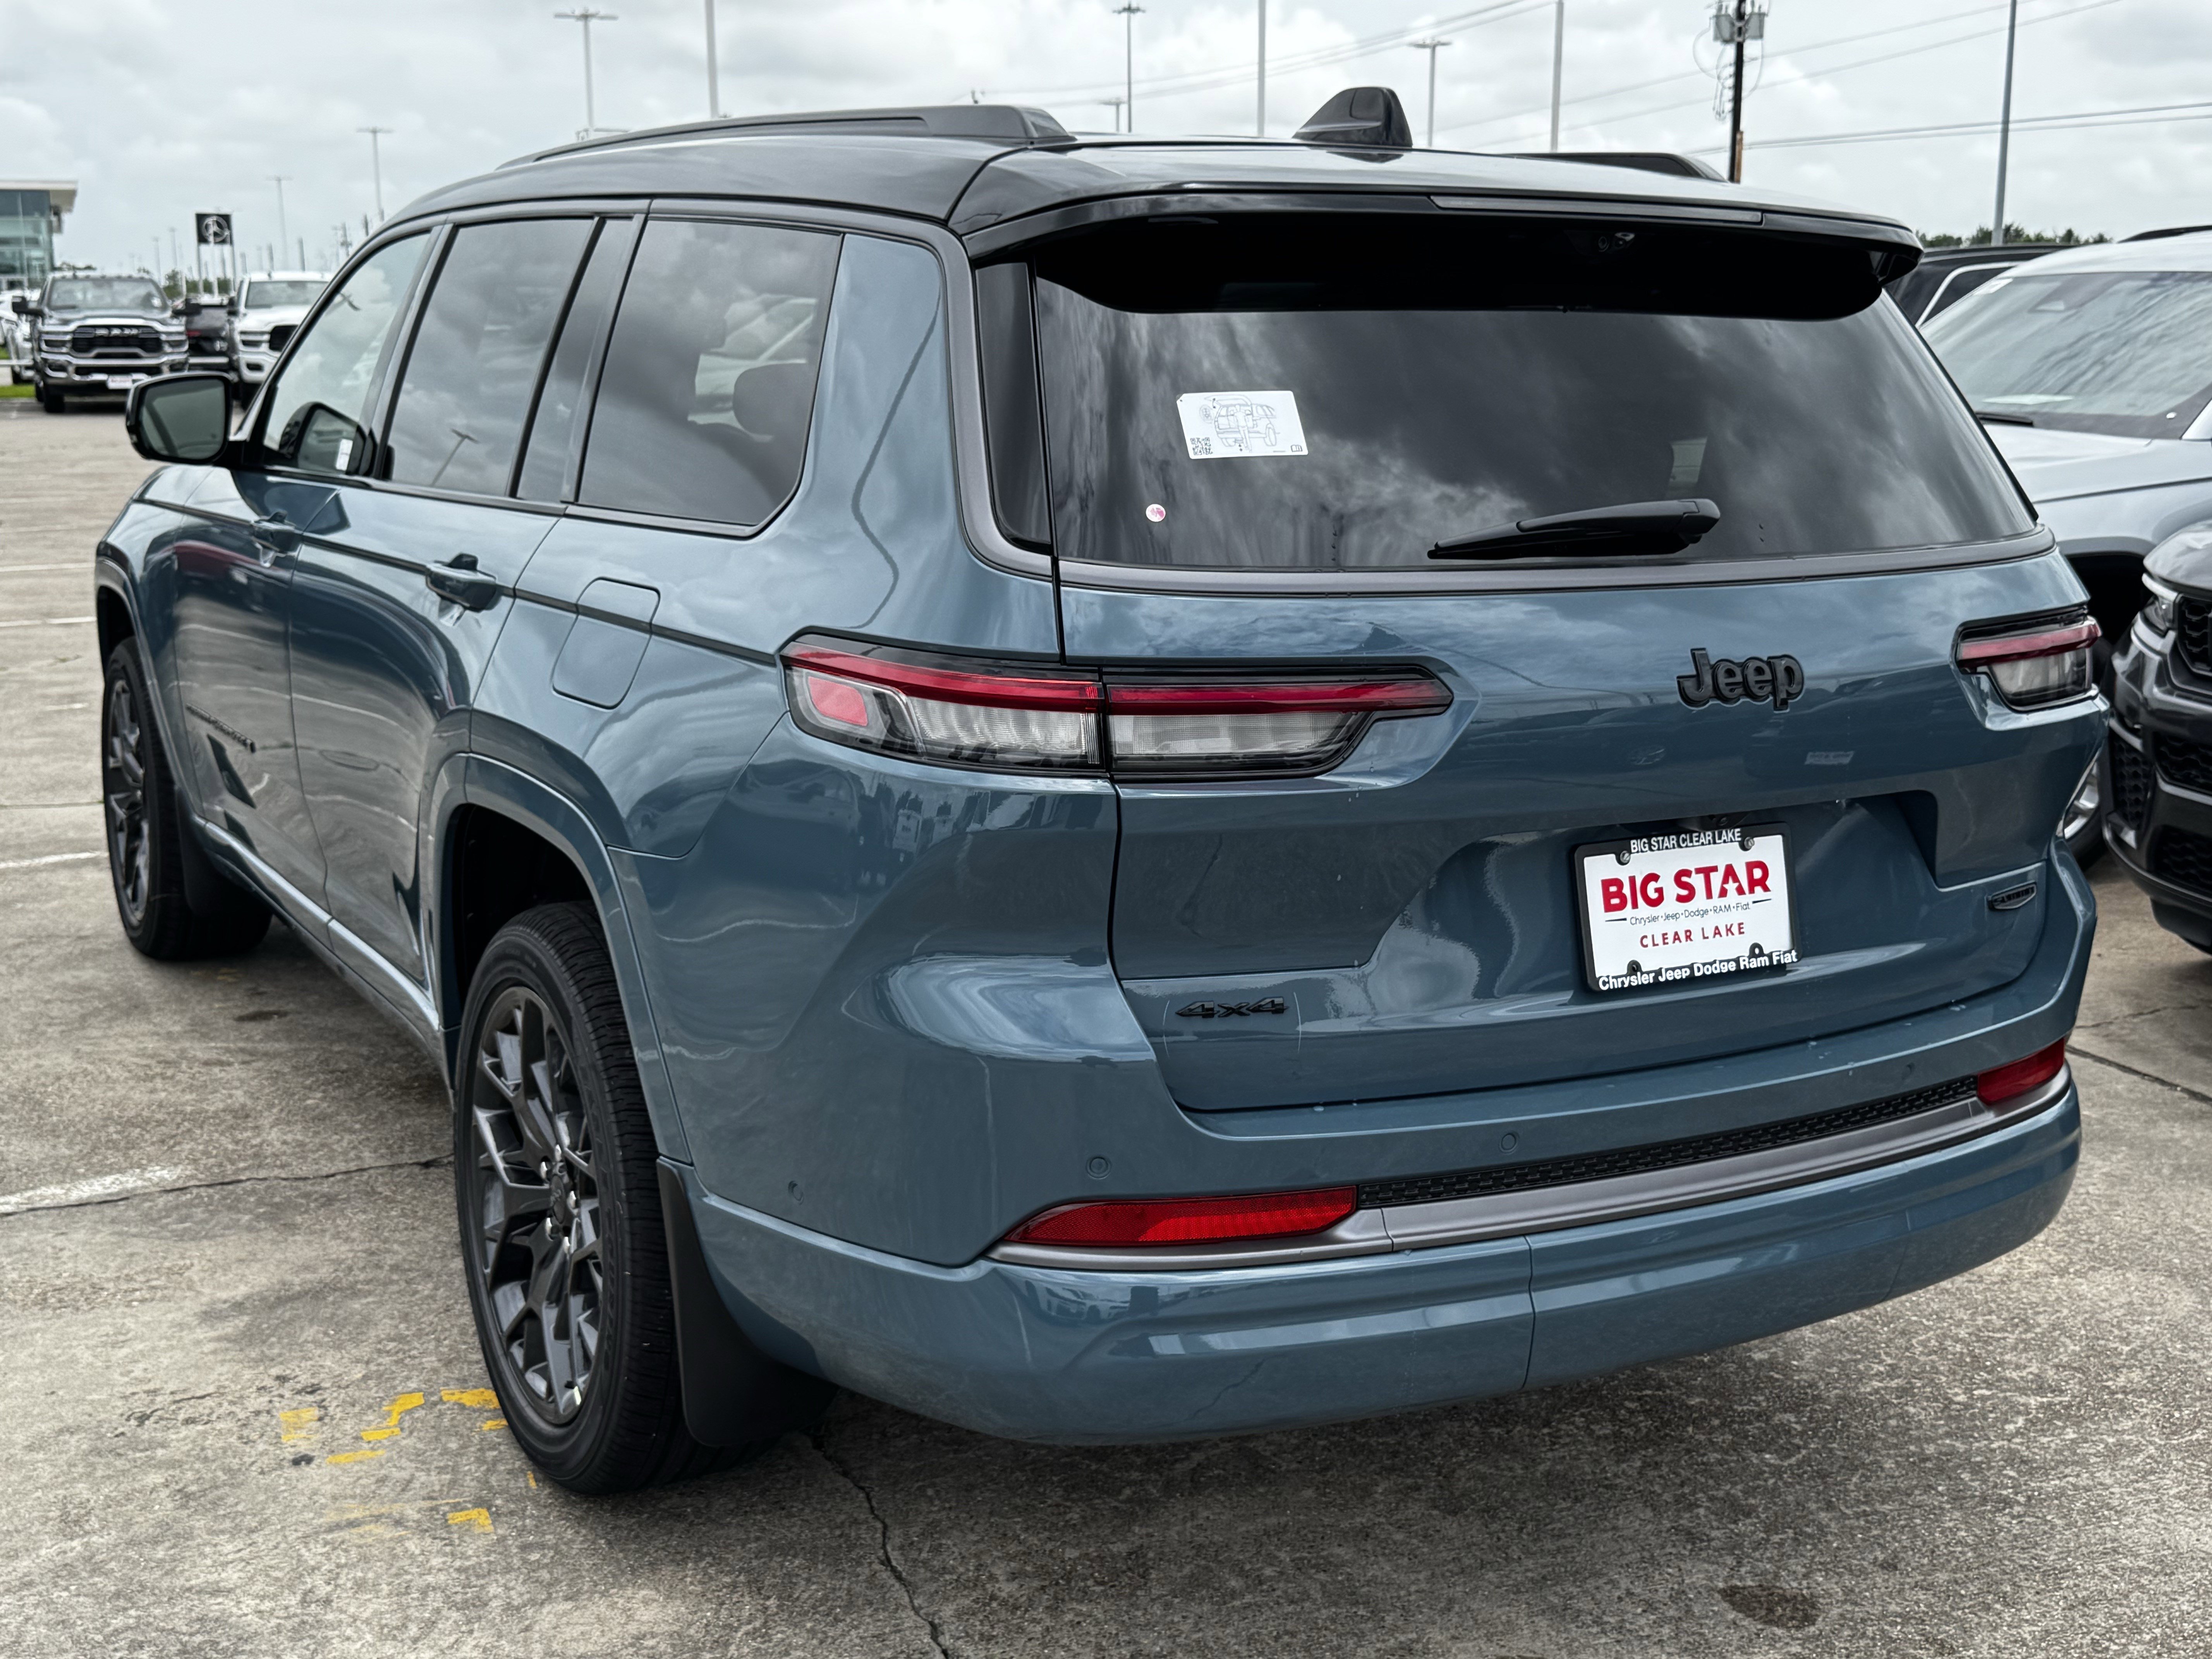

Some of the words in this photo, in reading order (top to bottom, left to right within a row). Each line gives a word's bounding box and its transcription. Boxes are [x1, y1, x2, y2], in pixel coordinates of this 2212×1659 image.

[1676, 647, 1804, 712] Jeep
[1630, 838, 1649, 853] BIG
[1651, 835, 1678, 850] STAR
[1679, 831, 1713, 847] CLEAR
[1715, 828, 1741, 843] LAKE
[1601, 872, 1664, 913] BIG
[1674, 860, 1771, 903] STAR
[1640, 929, 1693, 948] CLEAR
[1701, 922, 1745, 939] LAKE
[1599, 971, 1655, 991] Chrysler
[1659, 967, 1690, 982] Jeep
[1693, 959, 1736, 977] Dodge
[1739, 956, 1769, 969] Ram
[1772, 949, 1798, 965] Fiat
